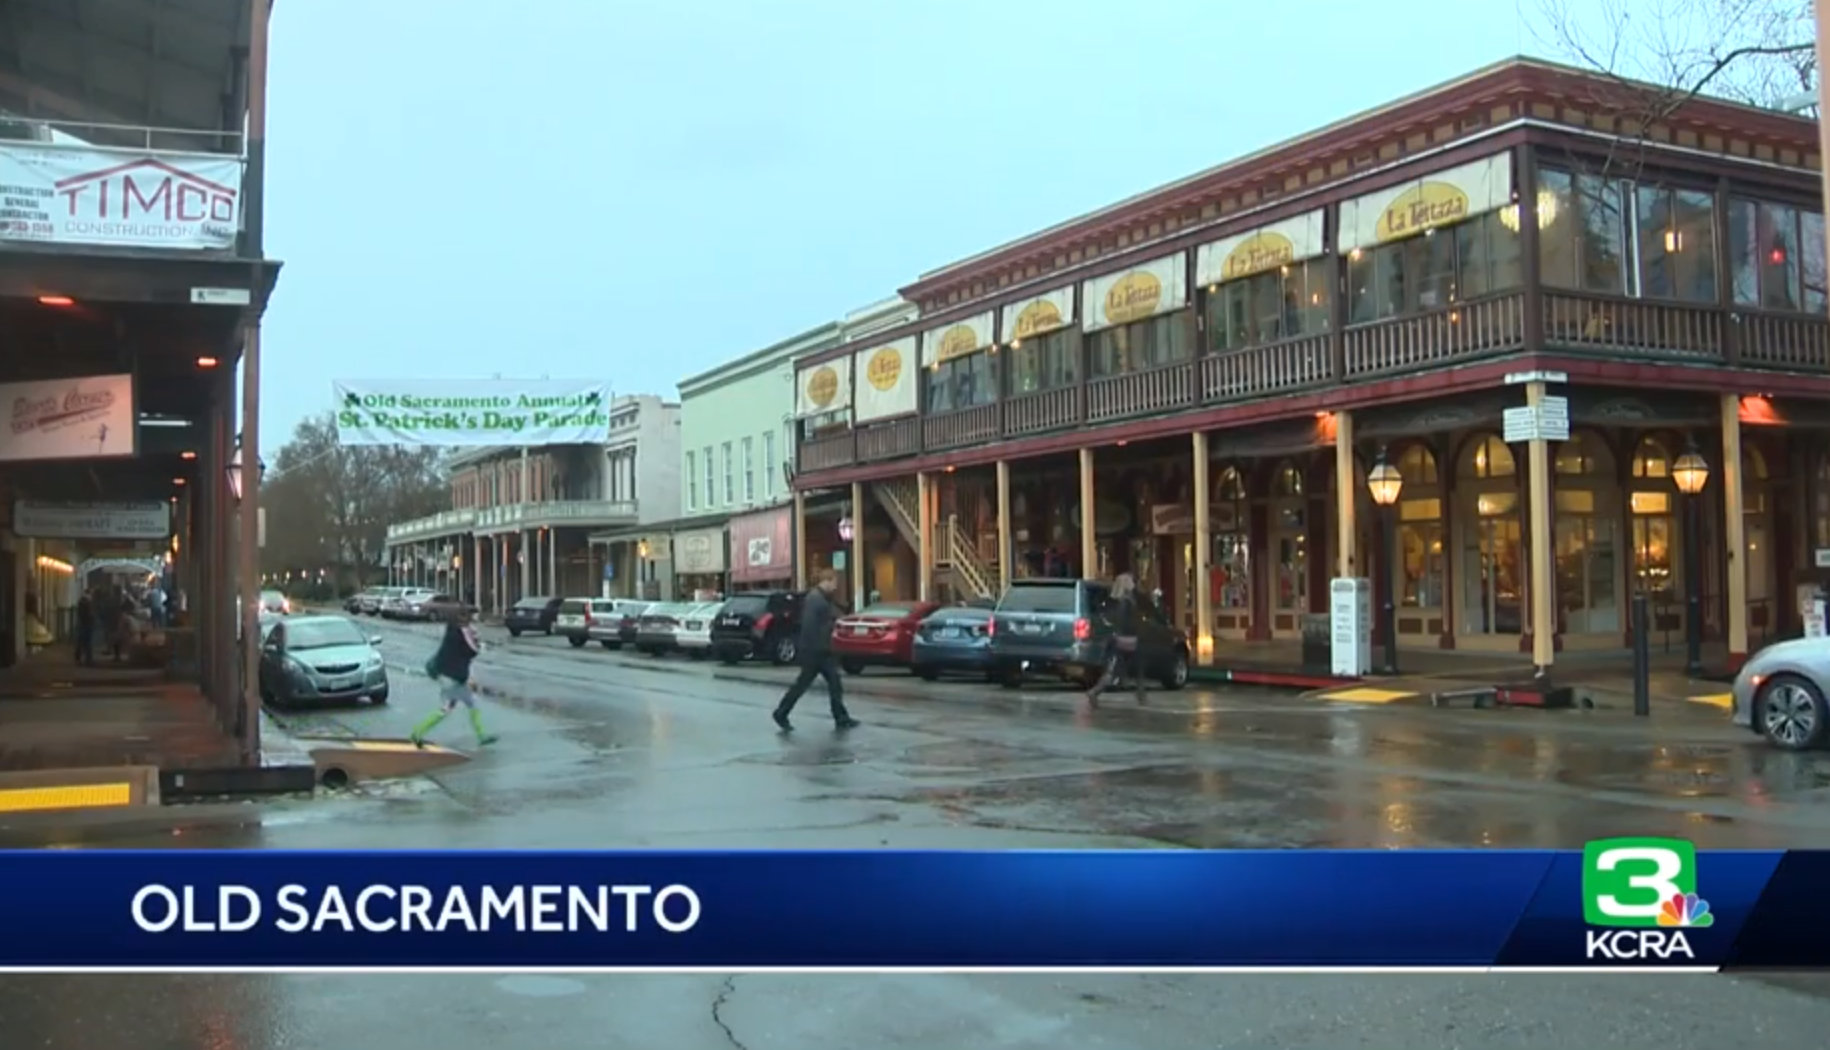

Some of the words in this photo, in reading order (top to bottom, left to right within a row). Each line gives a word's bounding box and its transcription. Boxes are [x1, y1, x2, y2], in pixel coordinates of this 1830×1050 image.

[59, 174, 233, 222] TIMCO
[363, 394, 396, 408] Old
[400, 394, 511, 408] Sacramento
[517, 394, 585, 408] Annual
[338, 411, 369, 428] St.
[373, 411, 477, 430] Patrick's
[483, 411, 527, 432] Day
[533, 408, 607, 428] Parade
